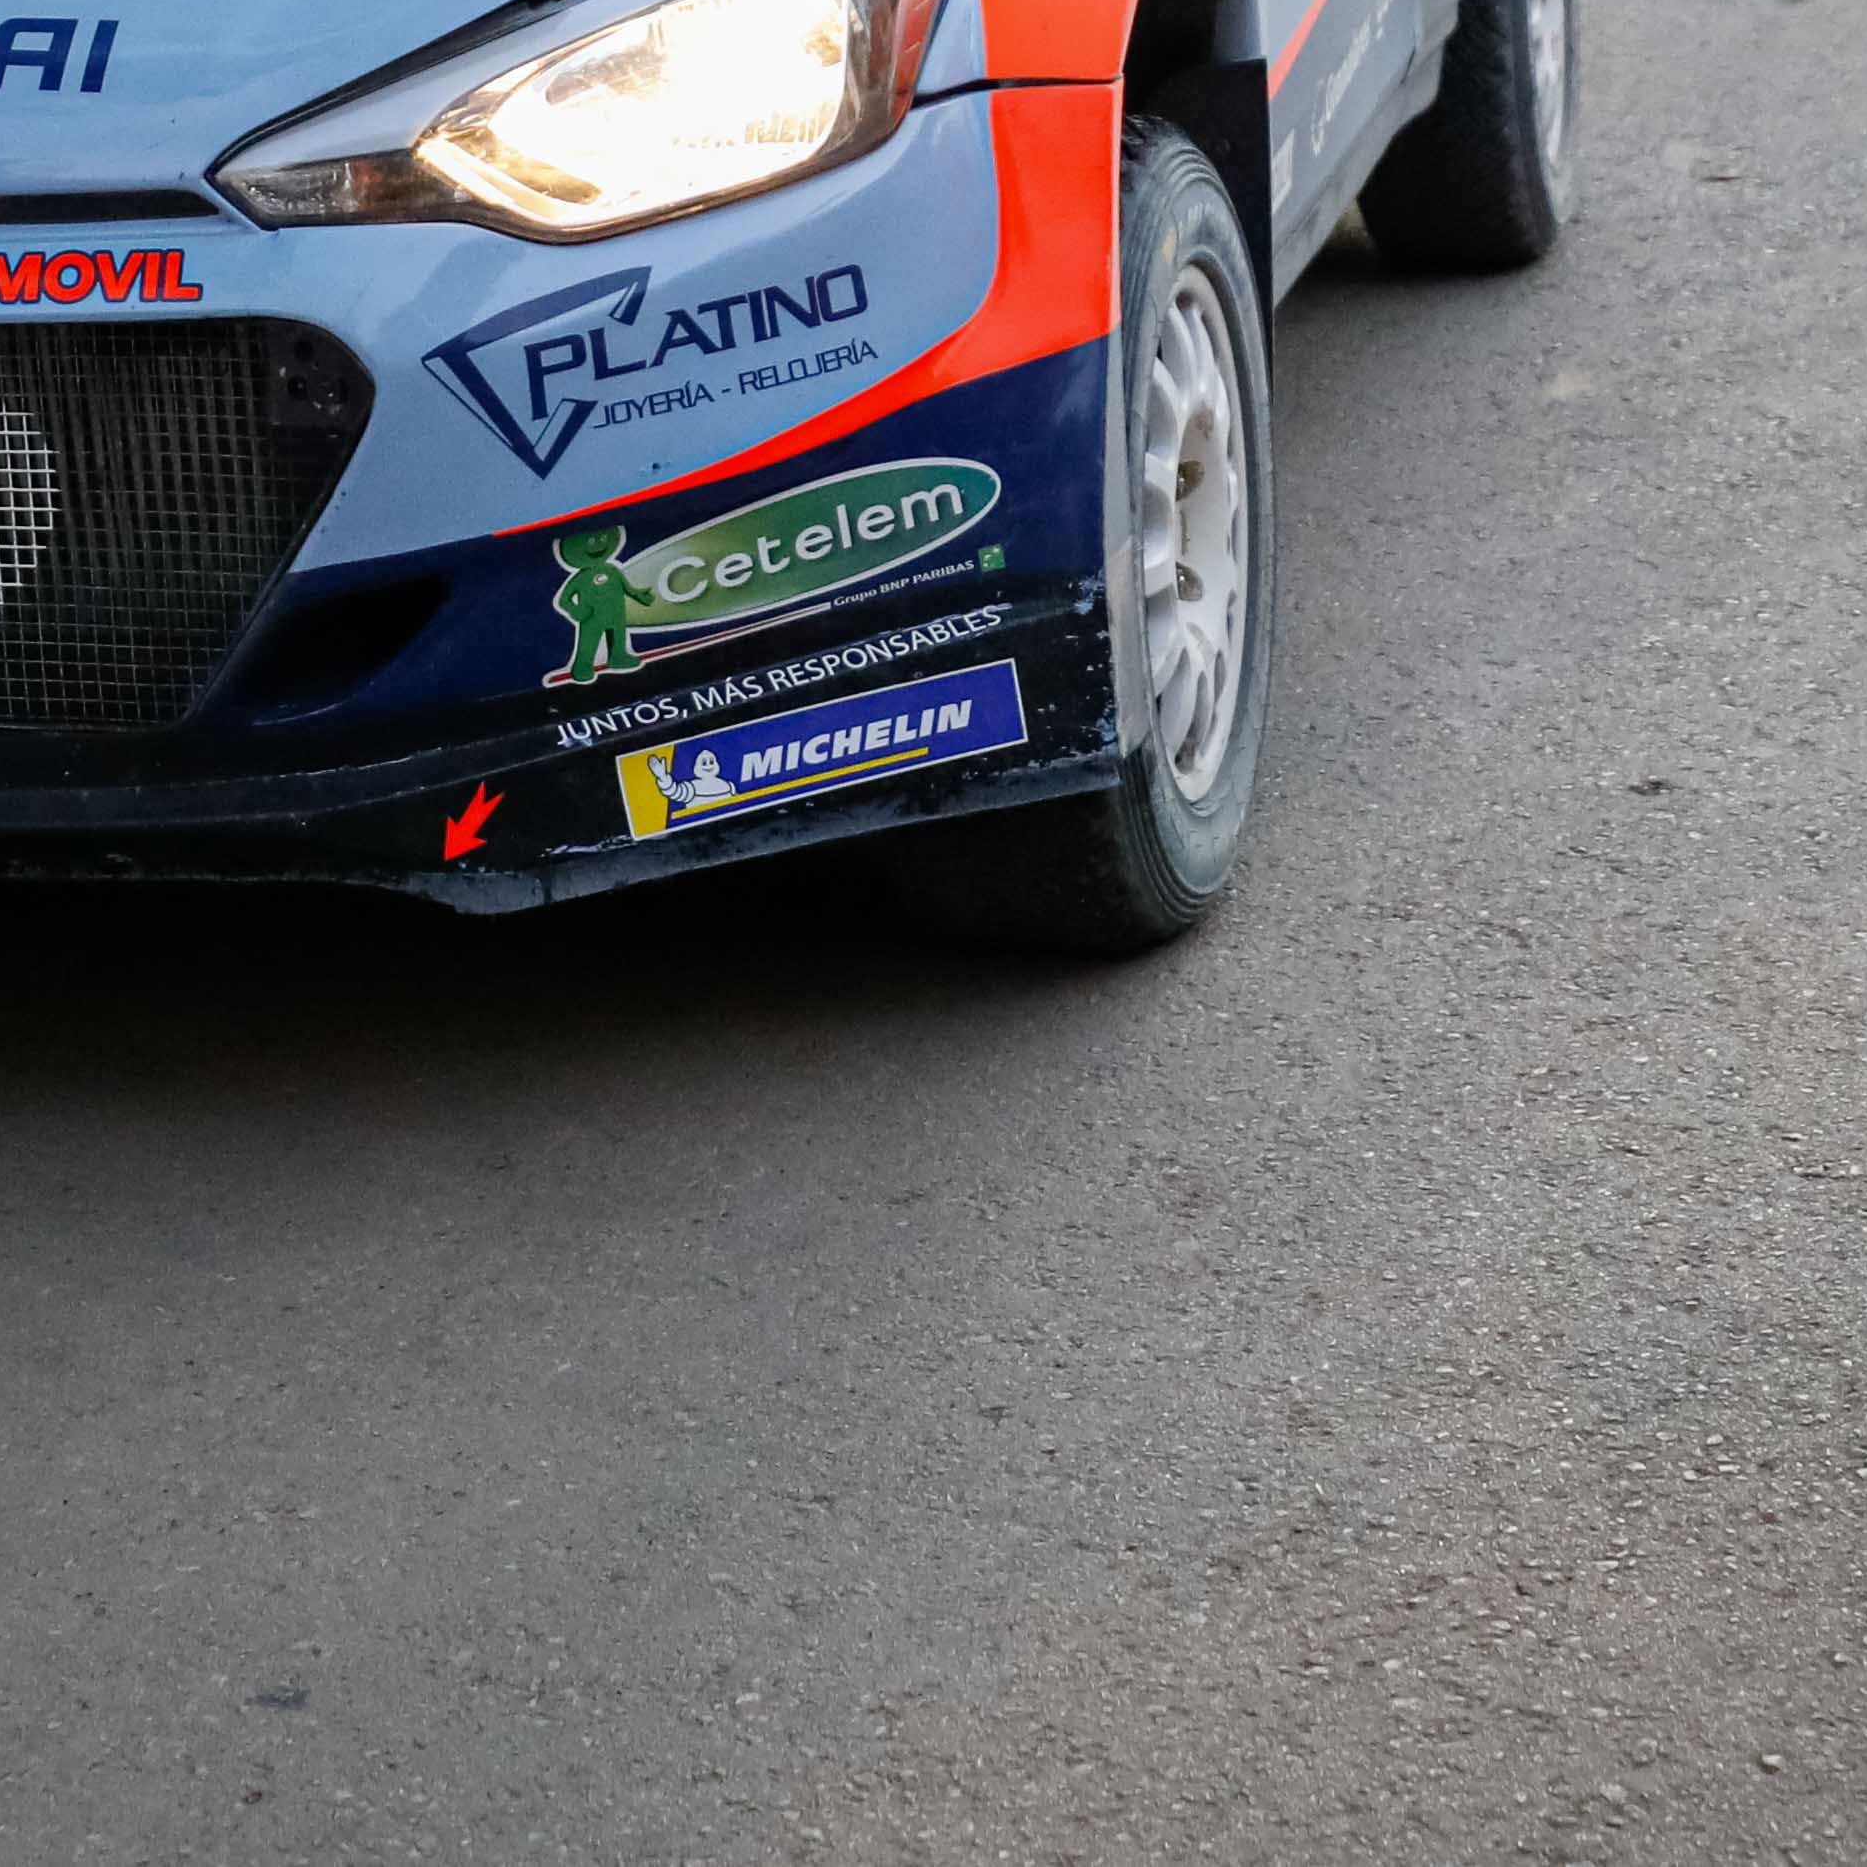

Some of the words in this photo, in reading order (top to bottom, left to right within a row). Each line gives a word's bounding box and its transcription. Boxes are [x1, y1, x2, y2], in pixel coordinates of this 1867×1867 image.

[524, 264, 868, 421] PLATINO
[594, 380, 715, 429] JOYERÍA
[738, 338, 879, 396] RELOJERÍA
[655, 478, 965, 605] Cetelem
[833, 588, 878, 608] Grupo
[879, 576, 912, 594] BNP
[912, 560, 975, 586] PARIBAS
[556, 697, 690, 746] JUNTOS,
[692, 672, 764, 712] MÁS
[769, 605, 1003, 692] RESPONSABLES
[740, 699, 973, 783] MICHELIN
